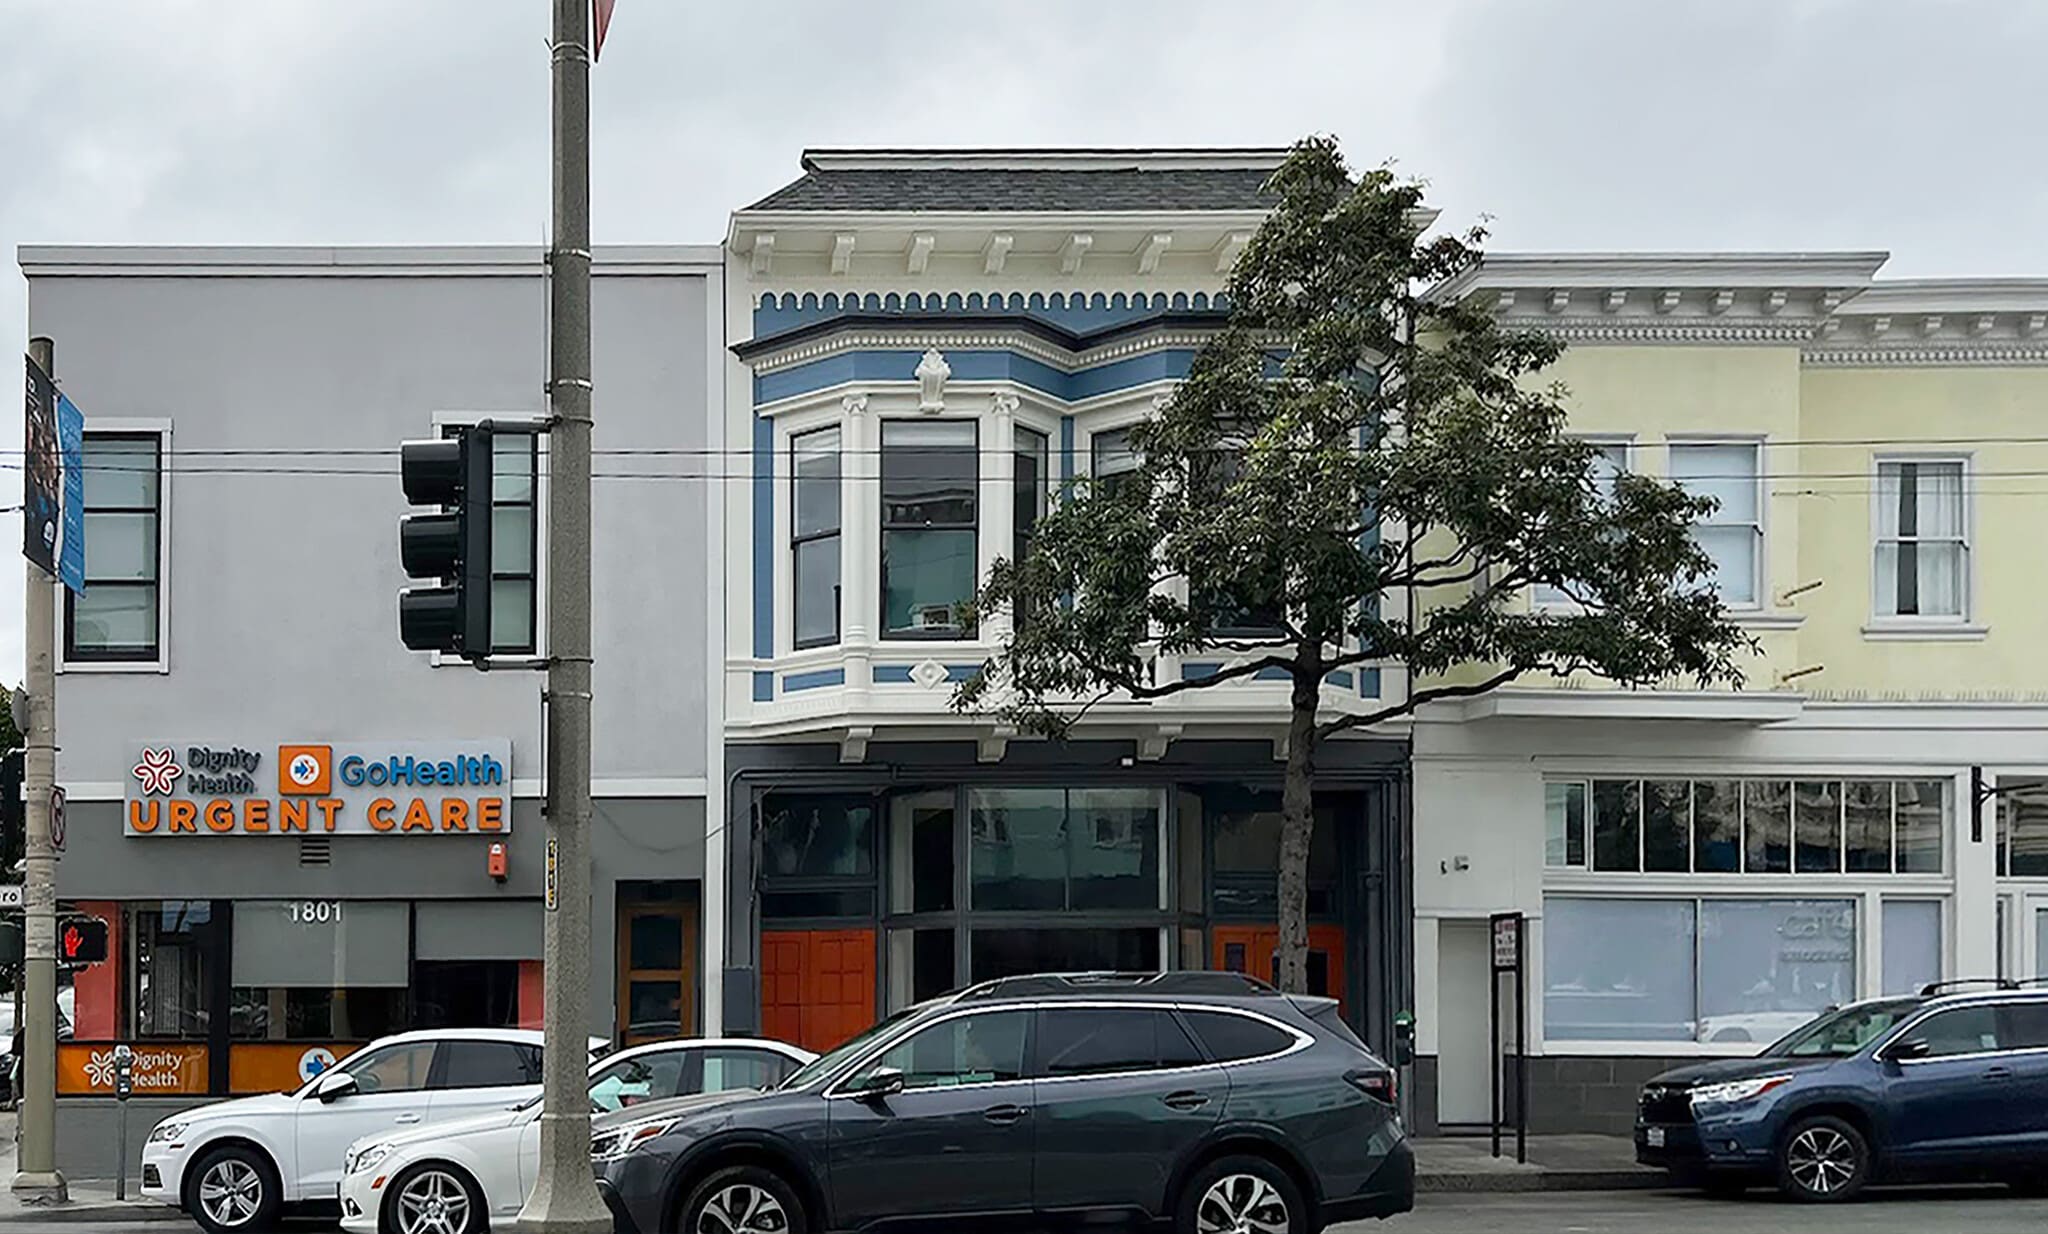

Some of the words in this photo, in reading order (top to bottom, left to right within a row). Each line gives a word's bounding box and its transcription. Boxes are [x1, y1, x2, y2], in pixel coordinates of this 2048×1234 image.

[187, 747, 262, 773] Dignity
[338, 754, 503, 787] GoHealth
[187, 773, 255, 794] Health
[130, 799, 345, 833] URGENT
[367, 797, 503, 831] CARE
[289, 901, 342, 922] 1801
